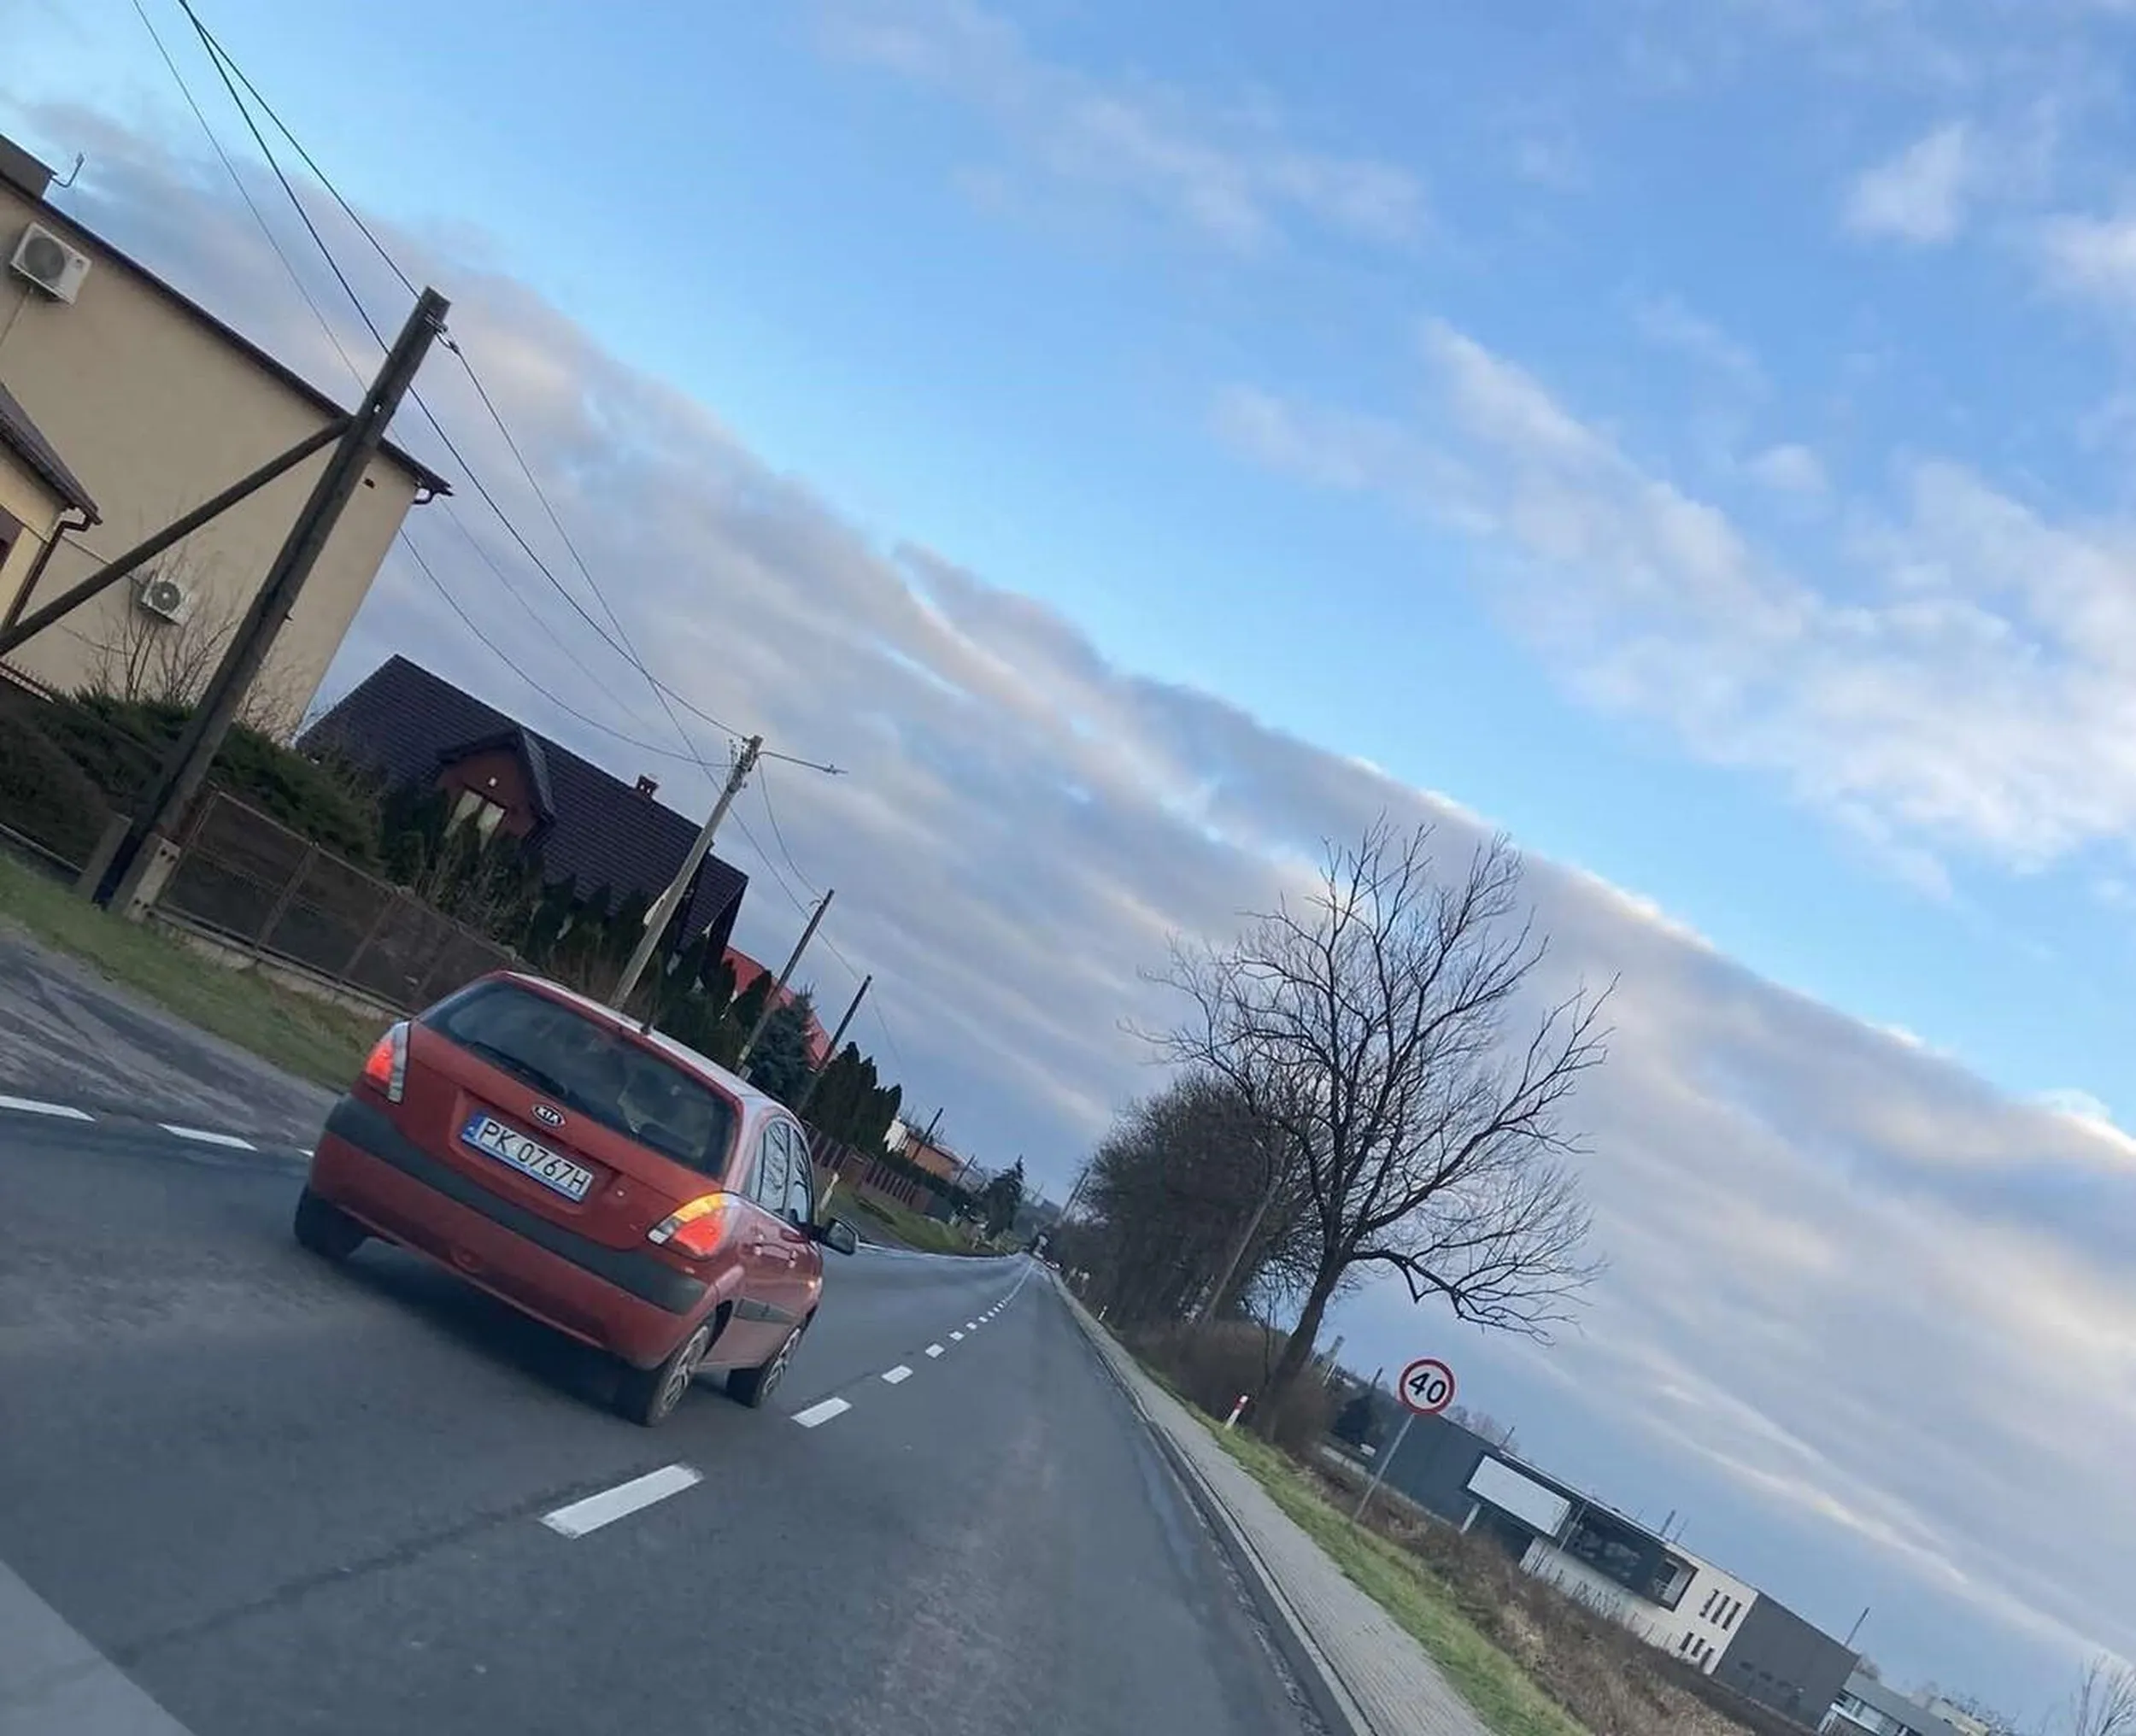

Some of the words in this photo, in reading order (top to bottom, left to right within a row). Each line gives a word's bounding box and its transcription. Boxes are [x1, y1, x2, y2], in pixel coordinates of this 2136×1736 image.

[536, 1107, 560, 1124] KIA
[479, 1121, 515, 1153] PK
[518, 1142, 590, 1194] 0767H
[1409, 1372, 1446, 1404] 40
